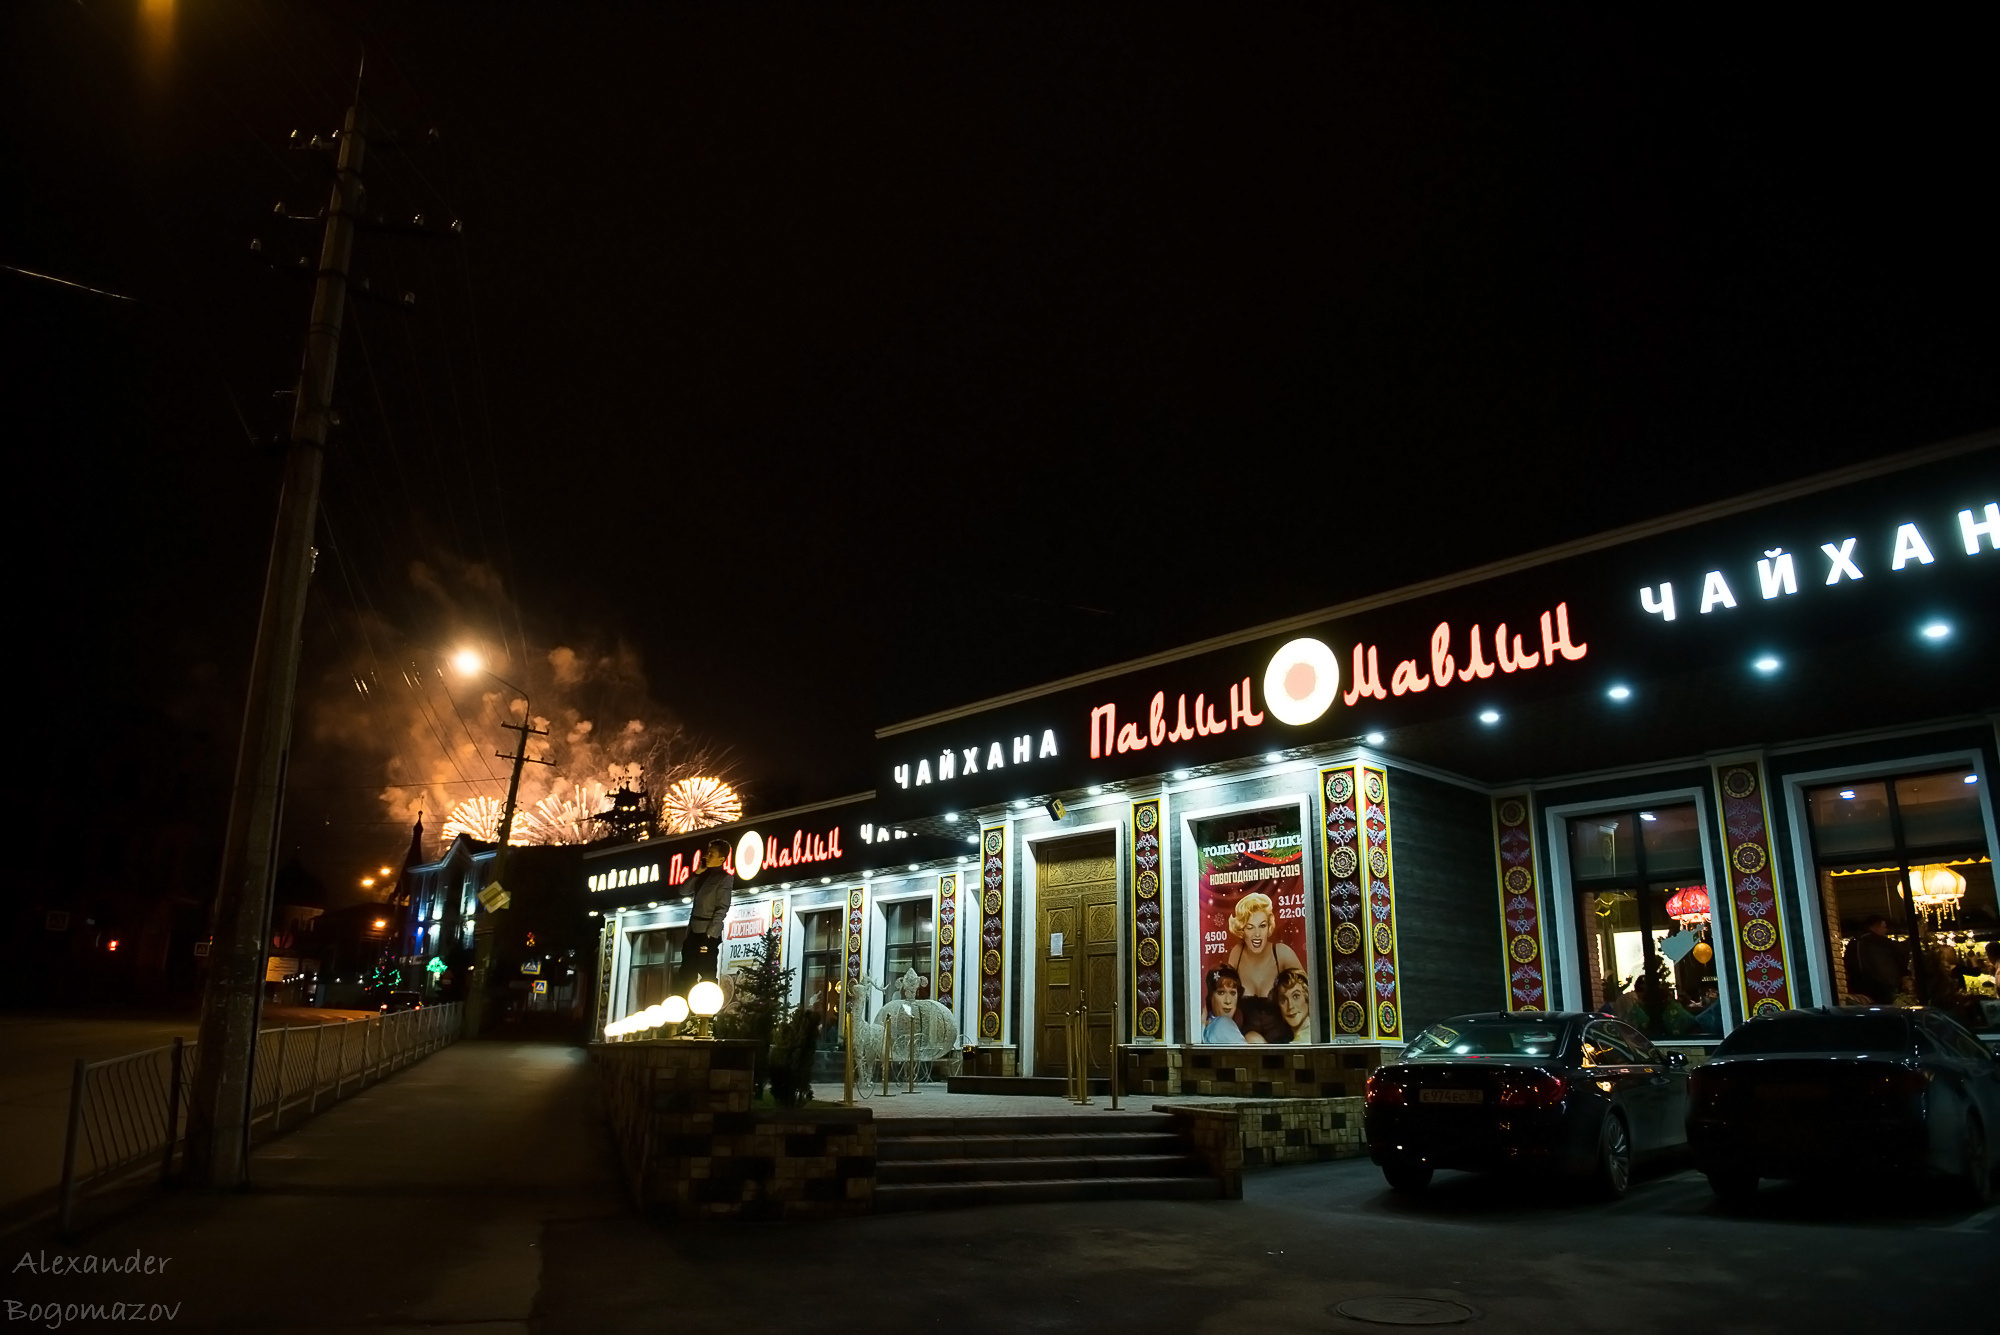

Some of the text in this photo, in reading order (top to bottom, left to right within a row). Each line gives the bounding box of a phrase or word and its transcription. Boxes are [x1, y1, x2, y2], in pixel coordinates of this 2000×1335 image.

[894, 729, 1058, 789] ЧАЙХАНА
[1090, 676, 1264, 759] Павлин
[1343, 601, 1588, 706] Мавлин
[1236, 825, 1277, 841] ДЖАЗЕ
[1203, 842, 1247, 857] ТОЛЬКО
[588, 863, 659, 892] ЧАЙХАНА
[763, 827, 842, 871] Мавлин
[1209, 869, 1258, 886] НОВОГОДНЯЯ
[1204, 930, 1228, 942] 4500
[1204, 943, 1228, 954] РУБ.
